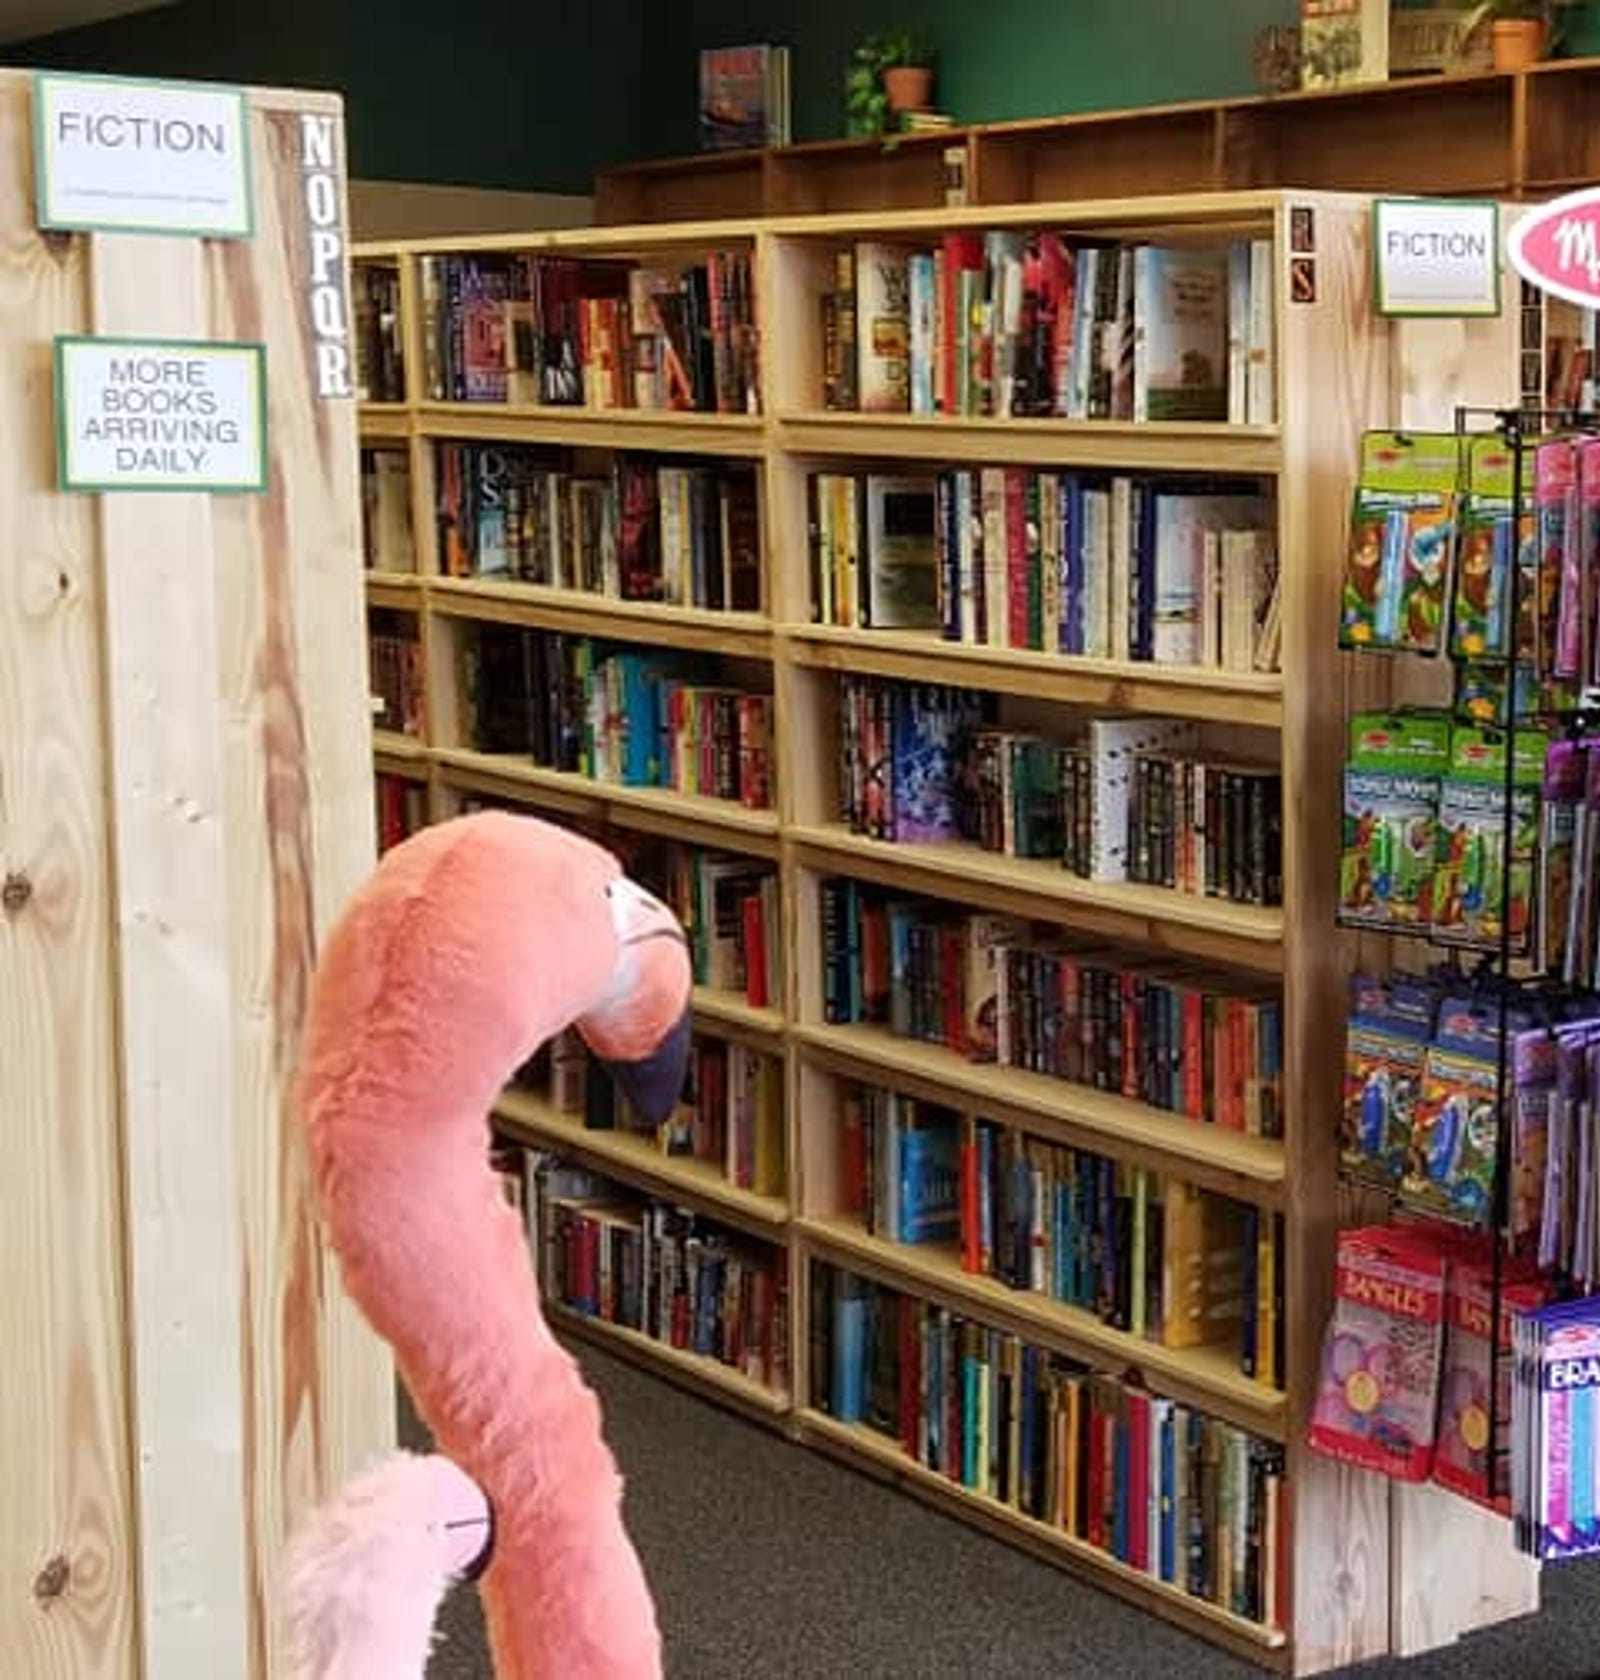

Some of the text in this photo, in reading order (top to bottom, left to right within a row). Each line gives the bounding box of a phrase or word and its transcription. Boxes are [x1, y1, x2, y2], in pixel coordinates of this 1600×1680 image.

[60, 111, 225, 153] FICTION
[1386, 231, 1486, 257] FICTION
[109, 358, 208, 387] MORE
[101, 388, 218, 415] BOOKS
[84, 416, 239, 444] ARRIVING
[115, 447, 208, 473] DAILY
[1344, 1270, 1426, 1319] BANGLES
